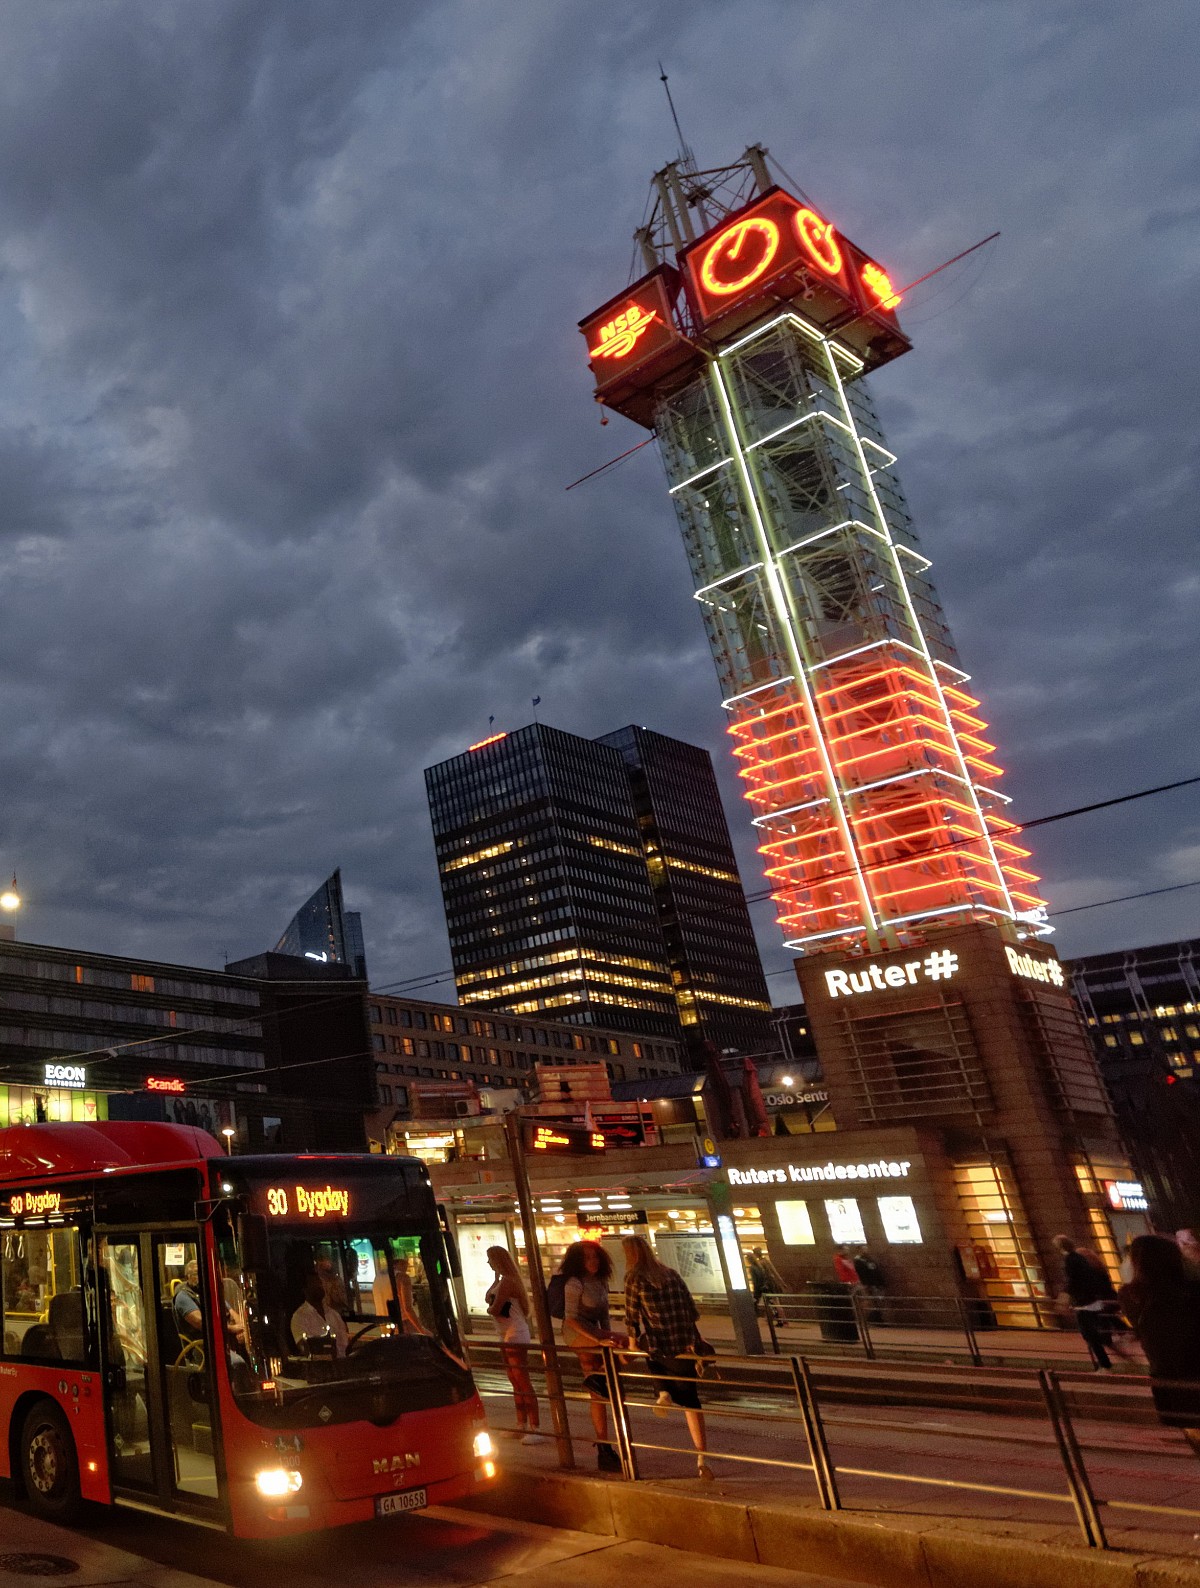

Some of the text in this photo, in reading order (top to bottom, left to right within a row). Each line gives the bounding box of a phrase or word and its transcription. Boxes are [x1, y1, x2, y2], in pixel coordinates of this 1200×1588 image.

[600, 306, 641, 343] NSB
[45, 1064, 86, 1081] EGON
[147, 1077, 185, 1091] Scandic
[766, 1093, 793, 1107] Oslo
[727, 1160, 912, 1185] Ruters kundesenter
[10, 1190, 61, 1214] 30 Bygdøy
[267, 1185, 349, 1218] 30 Bygdøy
[586, 1212, 639, 1222] Jernbanetorget
[372, 1452, 421, 1475] MAN
[383, 1490, 426, 1512] GA 10658
